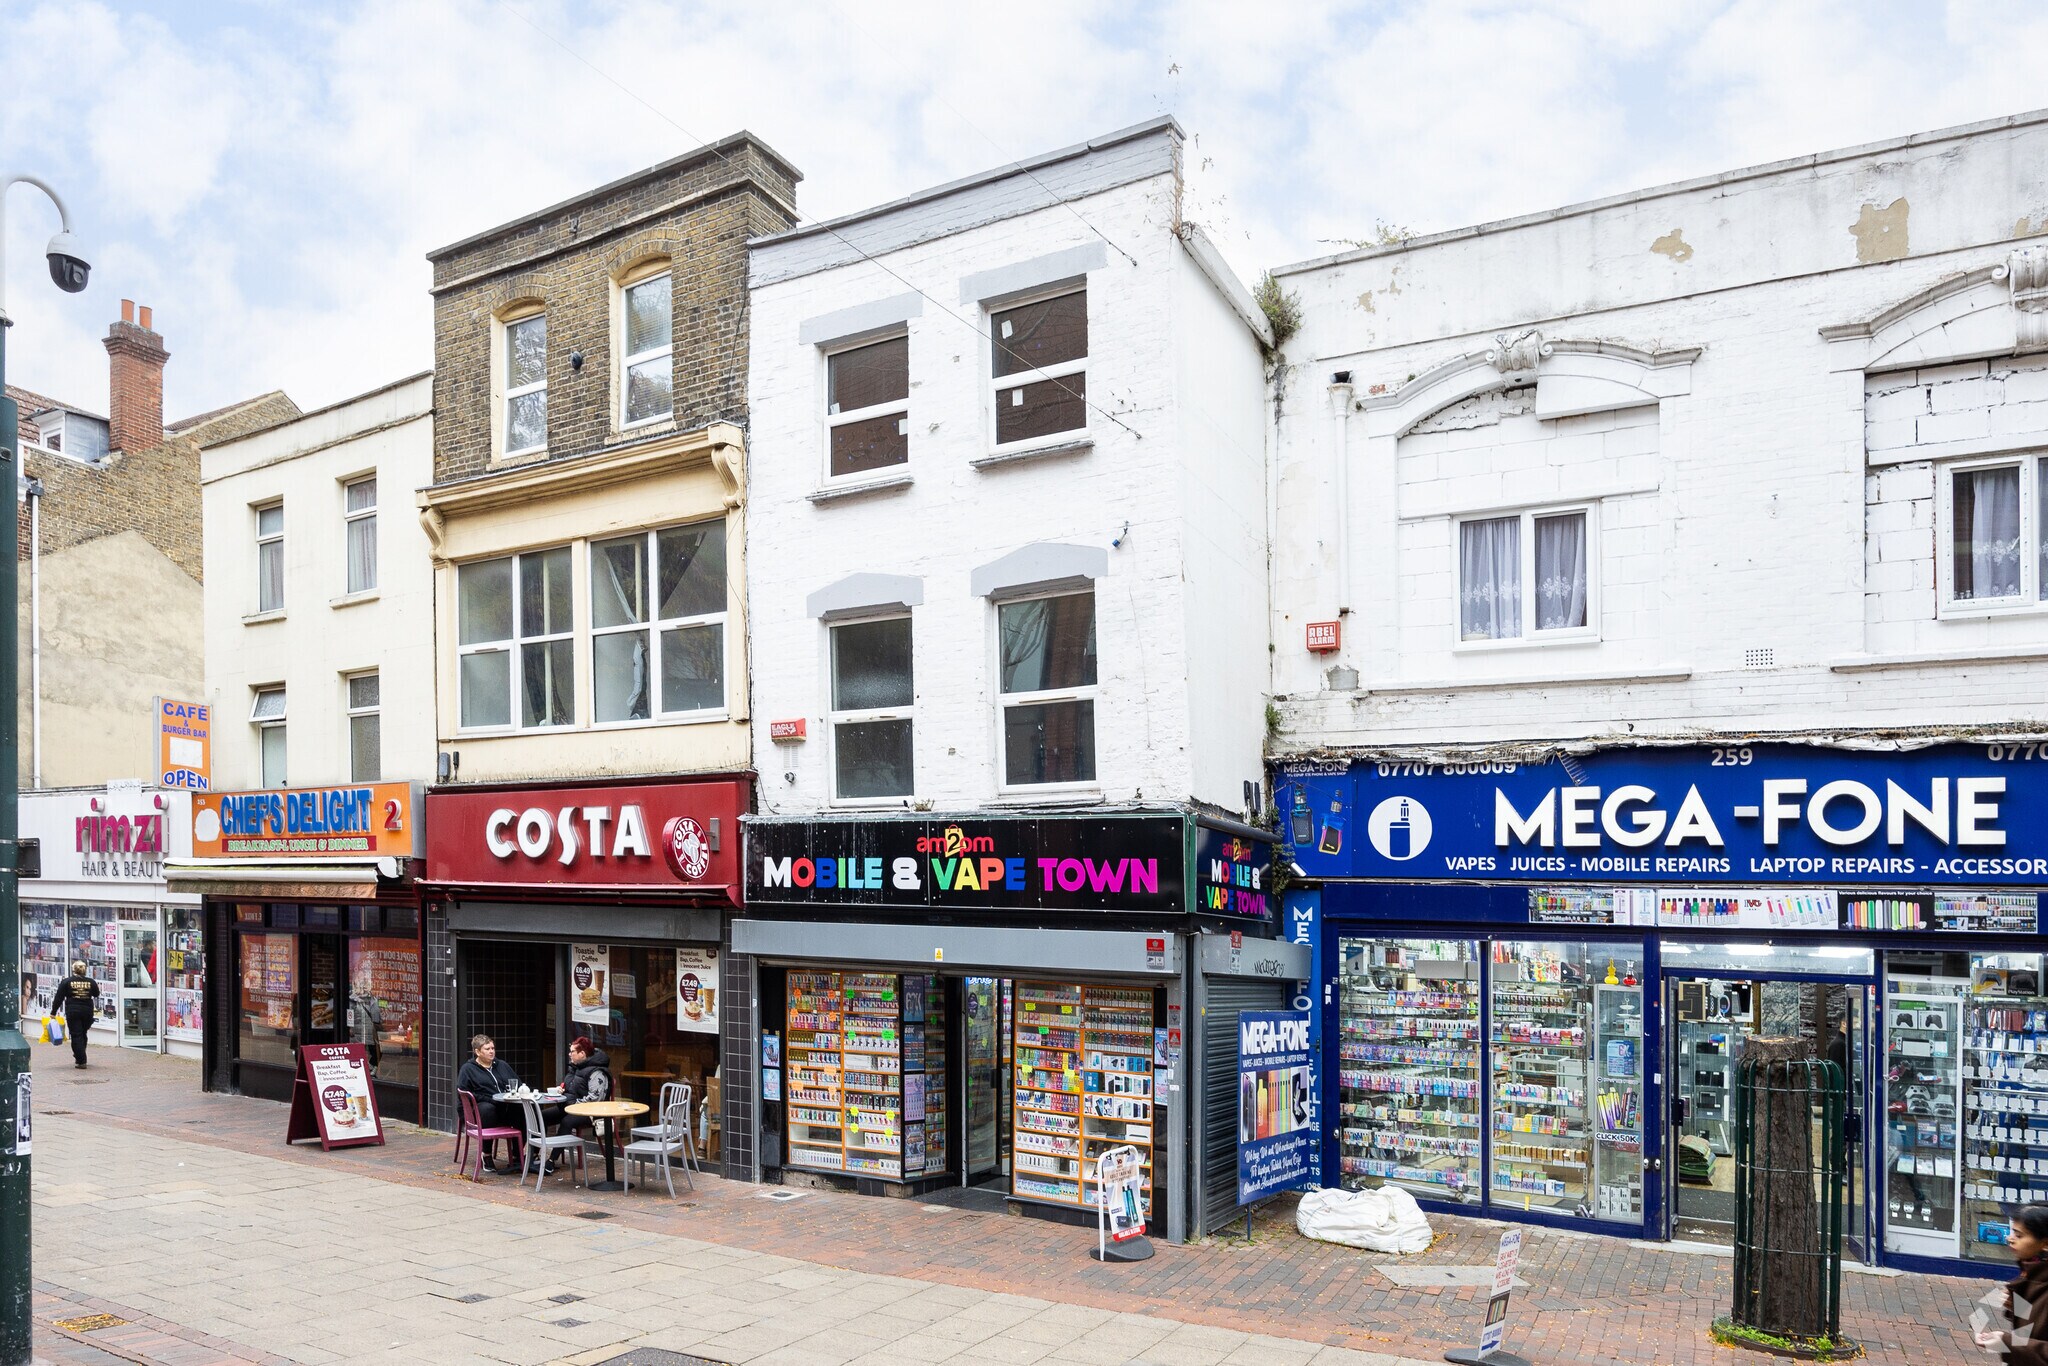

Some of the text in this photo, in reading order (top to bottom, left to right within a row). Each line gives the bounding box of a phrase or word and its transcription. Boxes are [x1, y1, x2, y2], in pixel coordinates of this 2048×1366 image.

[1309, 626, 1334, 637] ABEL
[1309, 637, 1334, 645] ALARM
[164, 702, 208, 722] CAFÉ
[162, 725, 206, 738] BURGER BAR
[1711, 748, 1753, 767] 259
[1284, 762, 1348, 773] MEGA-FONE
[164, 769, 208, 790] OPEN
[221, 788, 374, 836] CHEF'S DELIGHT
[384, 799, 403, 830] 2
[76, 794, 169, 853] rimzi
[318, 840, 327, 850] &
[328, 838, 369, 850] DINNER
[486, 805, 651, 866] COSTA
[676, 821, 694, 849] COSTA
[916, 829, 994, 858] am2pm
[82, 861, 162, 877] HAIR & BEAUT
[1212, 859, 1260, 889] MOBILE &
[1446, 857, 1496, 871] VAPES
[1510, 857, 1565, 872] JUICES
[1582, 858, 1650, 872] MOBILE
[1656, 858, 1730, 873] REPAIRS
[1750, 858, 1825, 873] LAPTOP
[1832, 858, 1914, 874] REPAIRS
[763, 856, 1158, 894] MOBILE & VAPE TOWN
[1206, 886, 1266, 915] VAPE TOWN
[575, 946, 595, 955] Toastie
[1242, 1021, 1309, 1055] MEGA-FONE
[321, 1047, 350, 1056] COSTA
[324, 1090, 345, 1098] £7.49
[1596, 1133, 1617, 1141] CLICK
